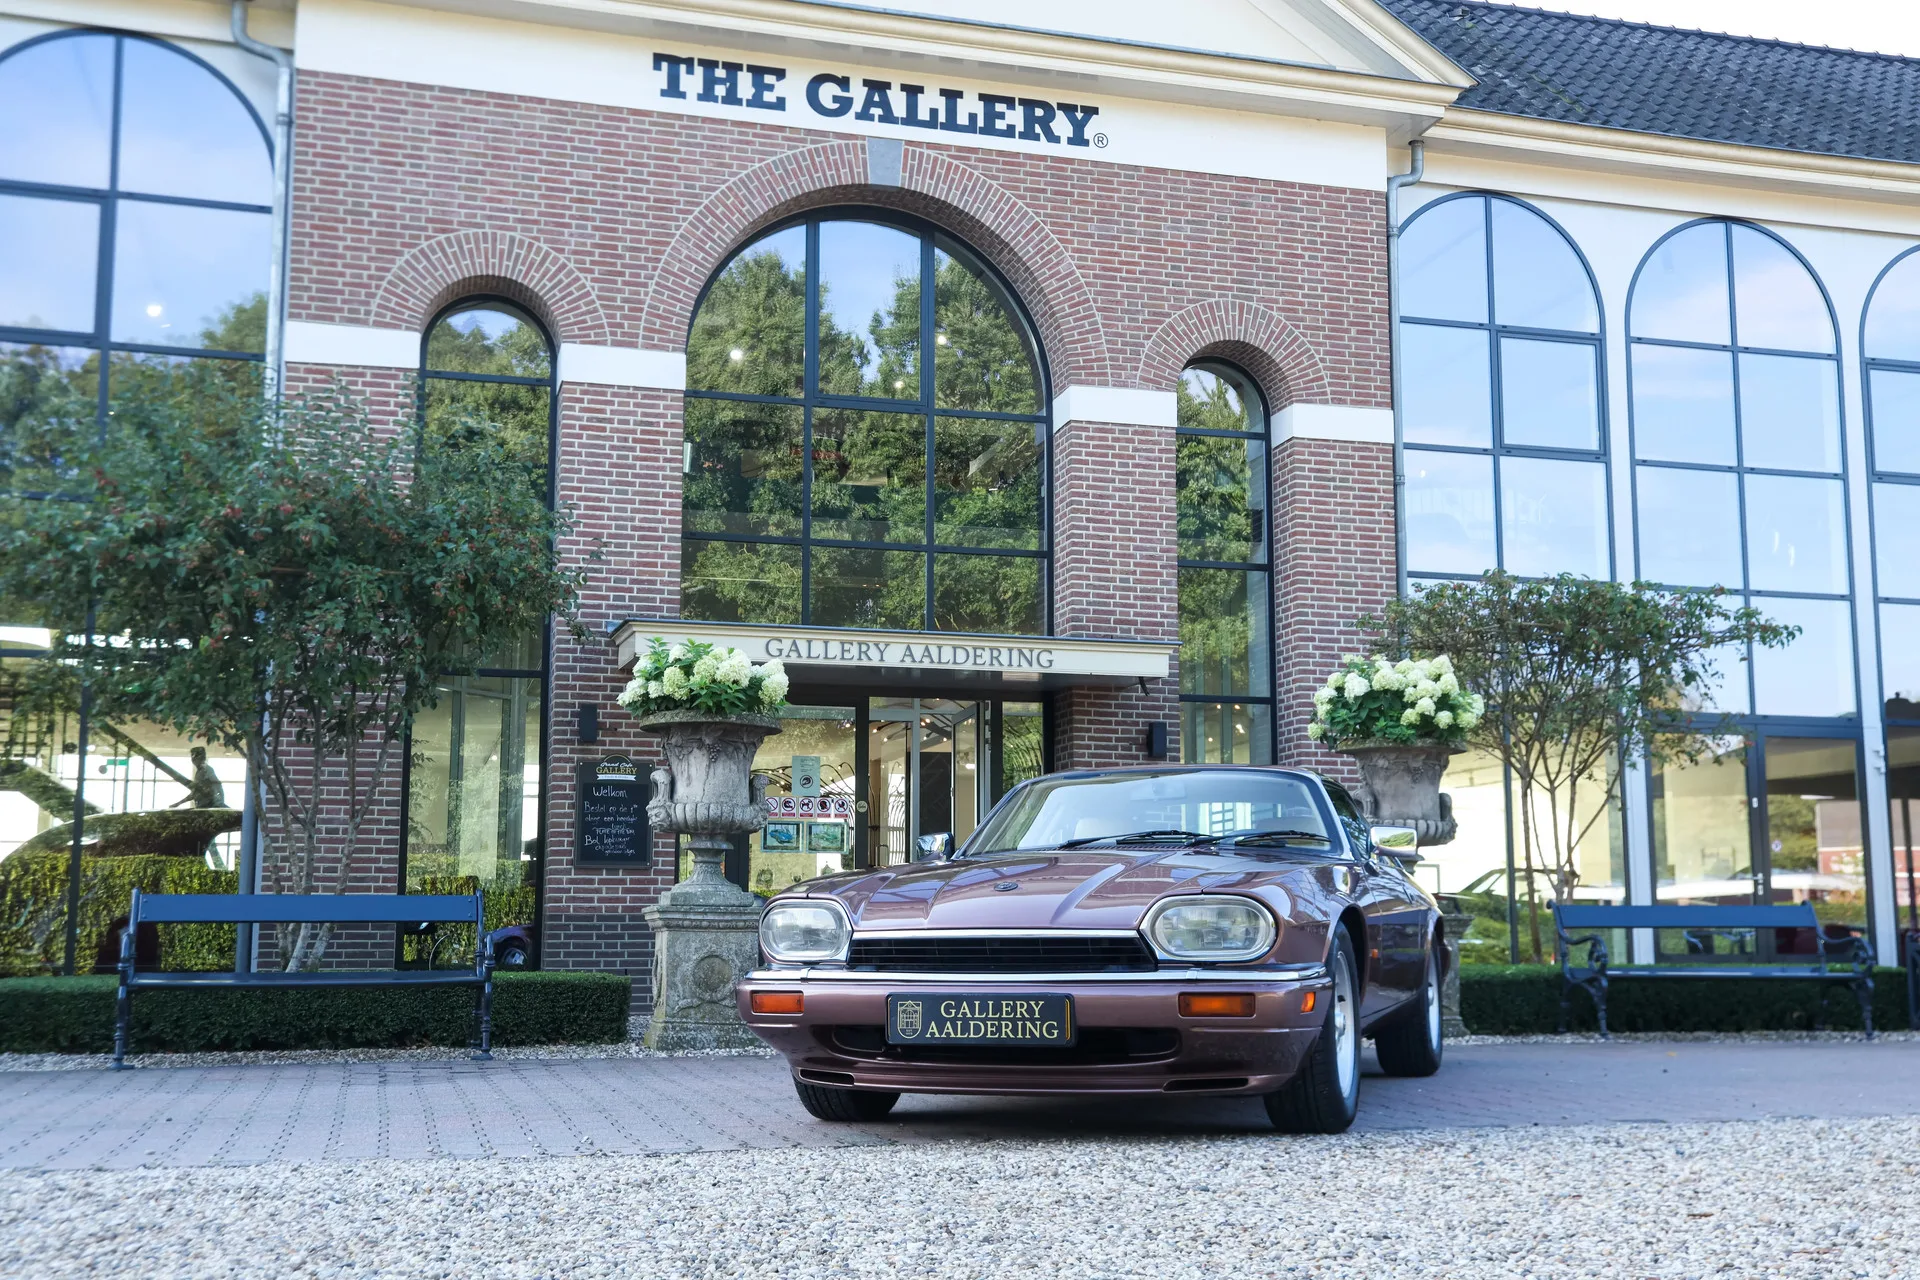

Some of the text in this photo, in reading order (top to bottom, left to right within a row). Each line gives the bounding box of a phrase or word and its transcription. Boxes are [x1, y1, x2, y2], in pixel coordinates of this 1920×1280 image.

[652, 52, 787, 112] THE
[765, 638, 1055, 669] GALLERY AALDERING
[596, 766, 638, 775] GALLERY
[593, 786, 628, 798] Welkom
[940, 1000, 1045, 1019] GALLERY
[925, 1020, 1059, 1039] AALDERING
